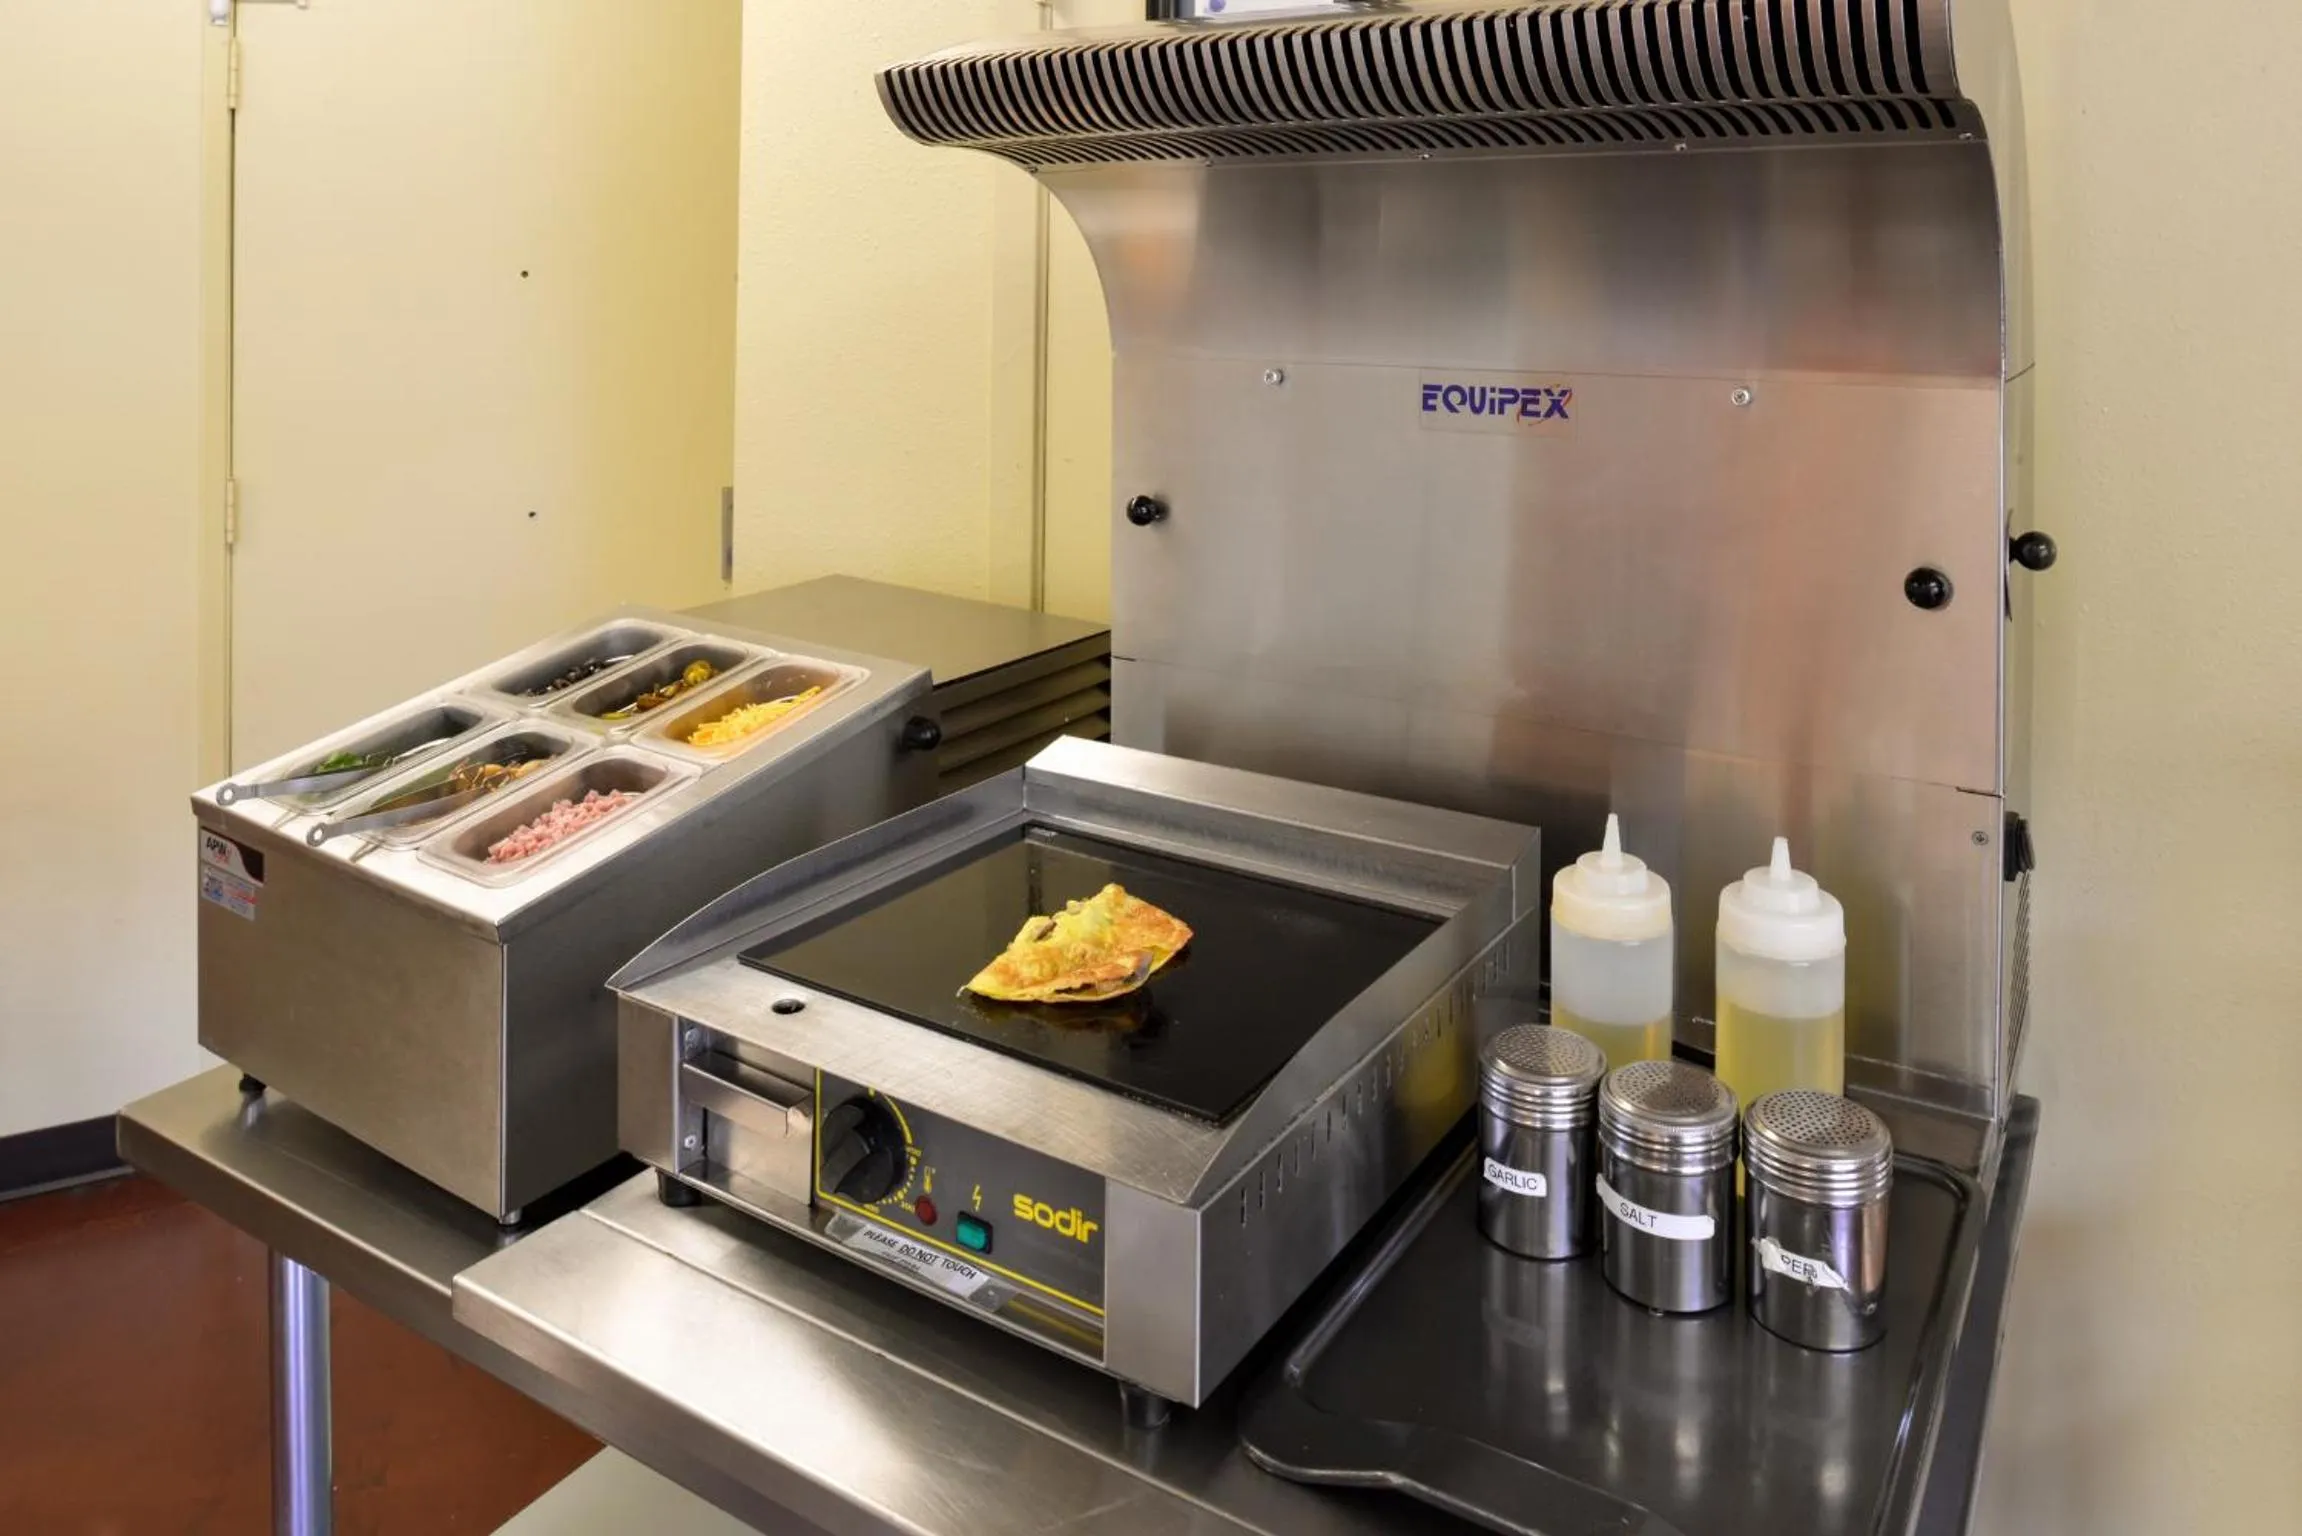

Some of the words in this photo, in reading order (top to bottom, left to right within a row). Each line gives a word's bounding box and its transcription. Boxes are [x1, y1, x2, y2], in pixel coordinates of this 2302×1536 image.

[1488, 1164, 1538, 1190] GARLIC
[1013, 1193, 1098, 1244] sodir
[1619, 1202, 1658, 1228] SALT
[864, 1229, 899, 1248] PLEASE
[900, 1244, 916, 1256] DO
[916, 1249, 939, 1265] NOT
[941, 1258, 977, 1280] TOUCH
